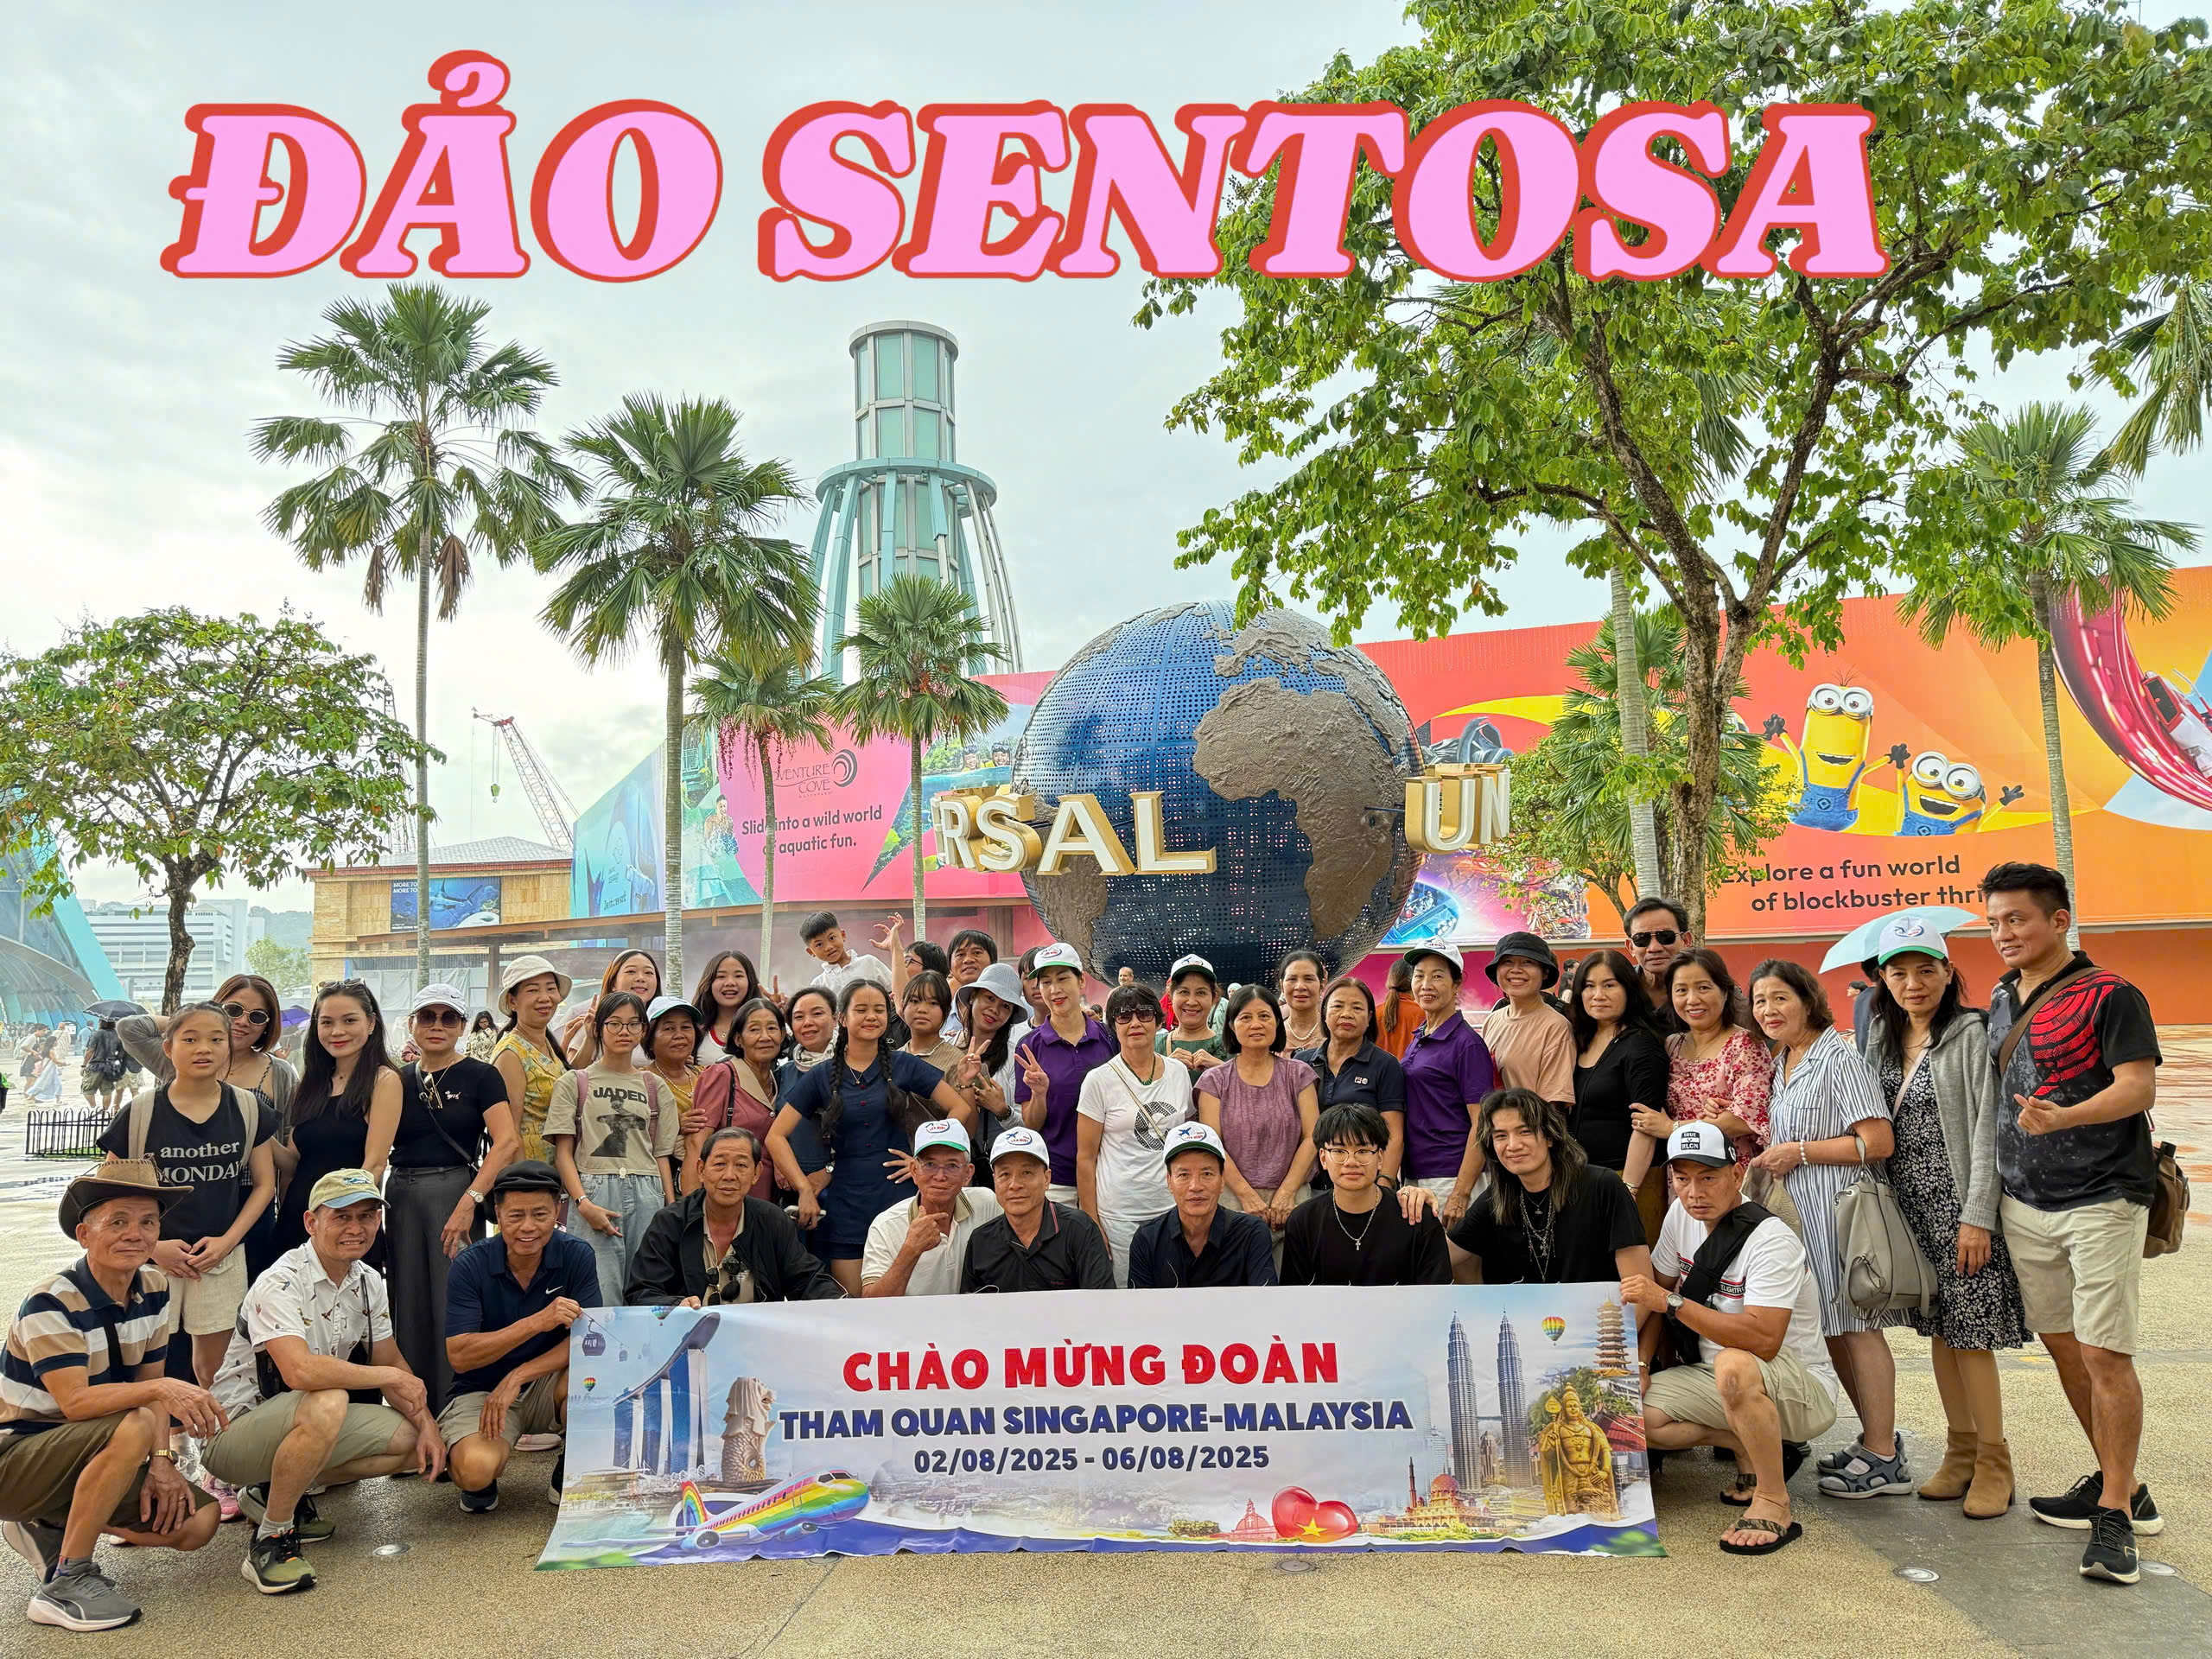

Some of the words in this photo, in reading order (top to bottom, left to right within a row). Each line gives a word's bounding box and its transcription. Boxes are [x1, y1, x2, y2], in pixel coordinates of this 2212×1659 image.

[798, 779, 830, 793] COVE
[742, 818, 767, 835] Slid
[775, 817, 799, 830] into
[802, 817, 810, 828] a
[813, 810, 840, 826] wild
[843, 804, 882, 823] world
[779, 836, 827, 856] aquatic
[830, 833, 856, 849] fun.
[1820, 867, 1834, 879] a
[1840, 859, 1881, 878] fun
[1887, 855, 1960, 876] world
[1751, 892, 1778, 912] of
[1783, 889, 1931, 911] blockbuster
[1937, 885, 1983, 904] thri
[593, 1087, 647, 1104] JADED
[160, 1141, 240, 1159] another
[842, 1342, 989, 1392] CHÀO
[1004, 1338, 1166, 1389] MỪNG
[1181, 1335, 1338, 1384] ĐOÀN
[779, 1409, 884, 1440] THAM
[891, 1407, 995, 1438] QUAN
[1003, 1401, 1414, 1435] SINGAPORE-MALAYSIA
[914, 1447, 1077, 1475] 02/08/2025
[1102, 1445, 1269, 1473] 06/08/2025
